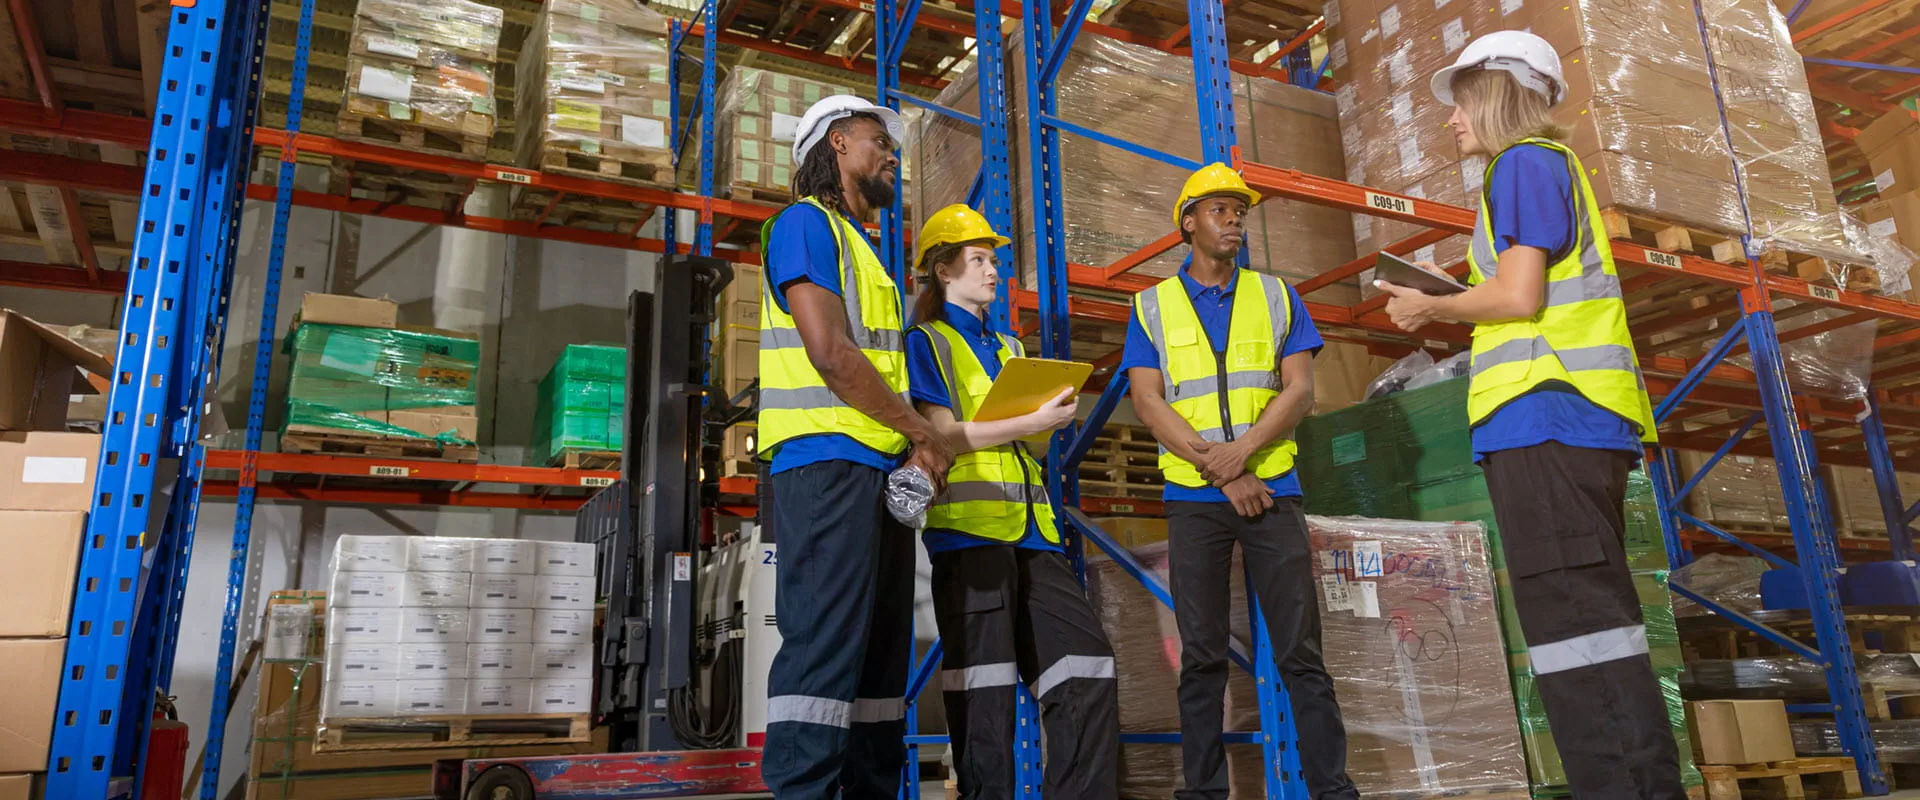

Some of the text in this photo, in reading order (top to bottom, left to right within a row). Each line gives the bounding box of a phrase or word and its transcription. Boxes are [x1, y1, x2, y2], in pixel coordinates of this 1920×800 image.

[1373, 195, 1406, 212] C09-01
[1650, 252, 1676, 267] C09-02
[376, 467, 402, 475] A09-01
[586, 478, 609, 486] A09-02
